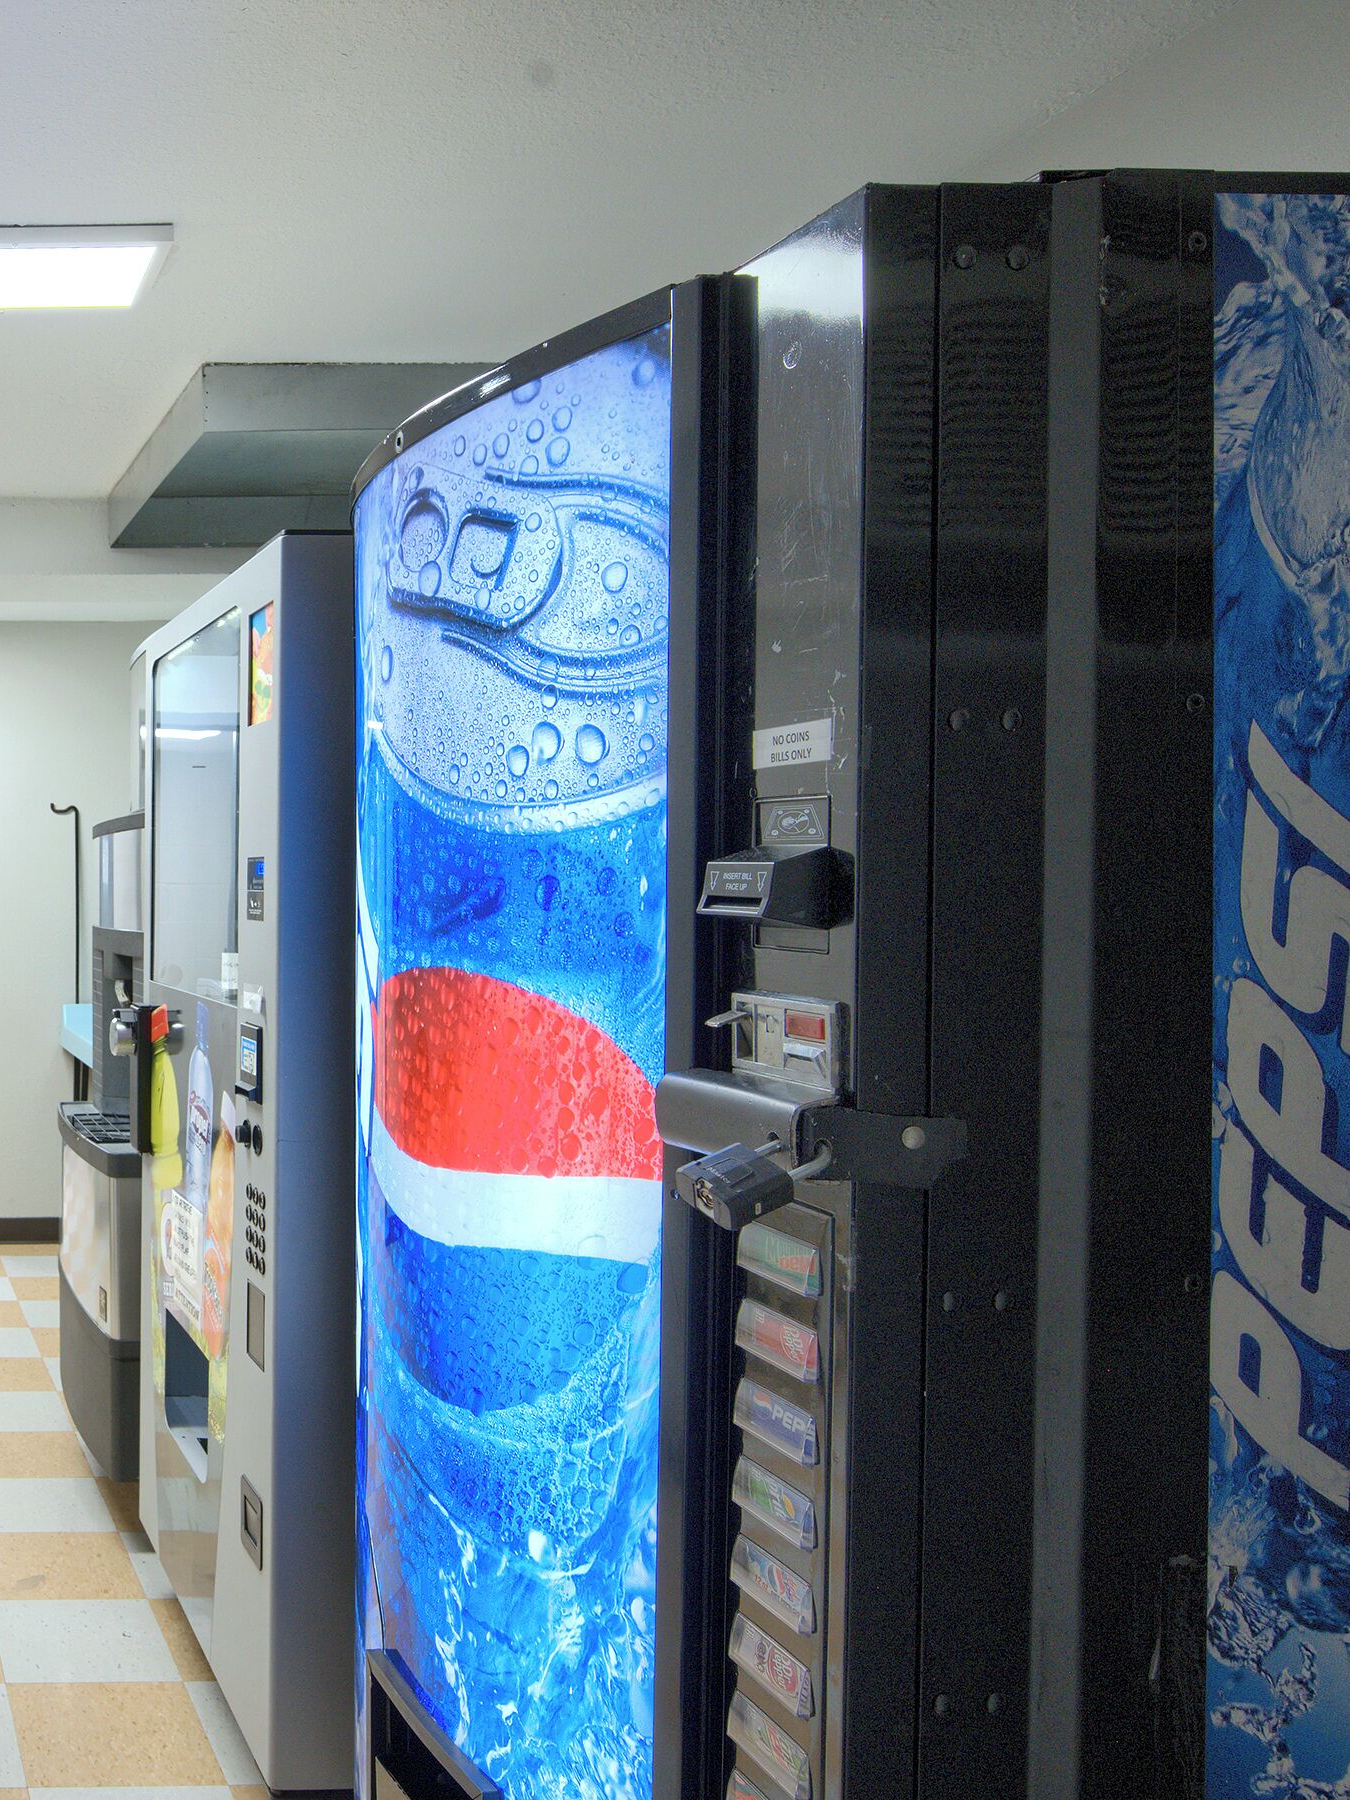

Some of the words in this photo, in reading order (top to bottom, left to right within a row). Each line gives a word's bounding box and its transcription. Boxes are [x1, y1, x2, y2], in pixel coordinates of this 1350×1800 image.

[772, 735, 785, 746] NO
[786, 731, 810, 744] COINS
[770, 751, 790, 763] BILLS
[791, 748, 812, 760] ONLY
[722, 872, 742, 880] INSERT
[742, 872, 753, 880] BILL
[725, 882, 739, 890] FACE
[739, 883, 748, 891] UP
[1209, 719, 1350, 1511] PEPSI
